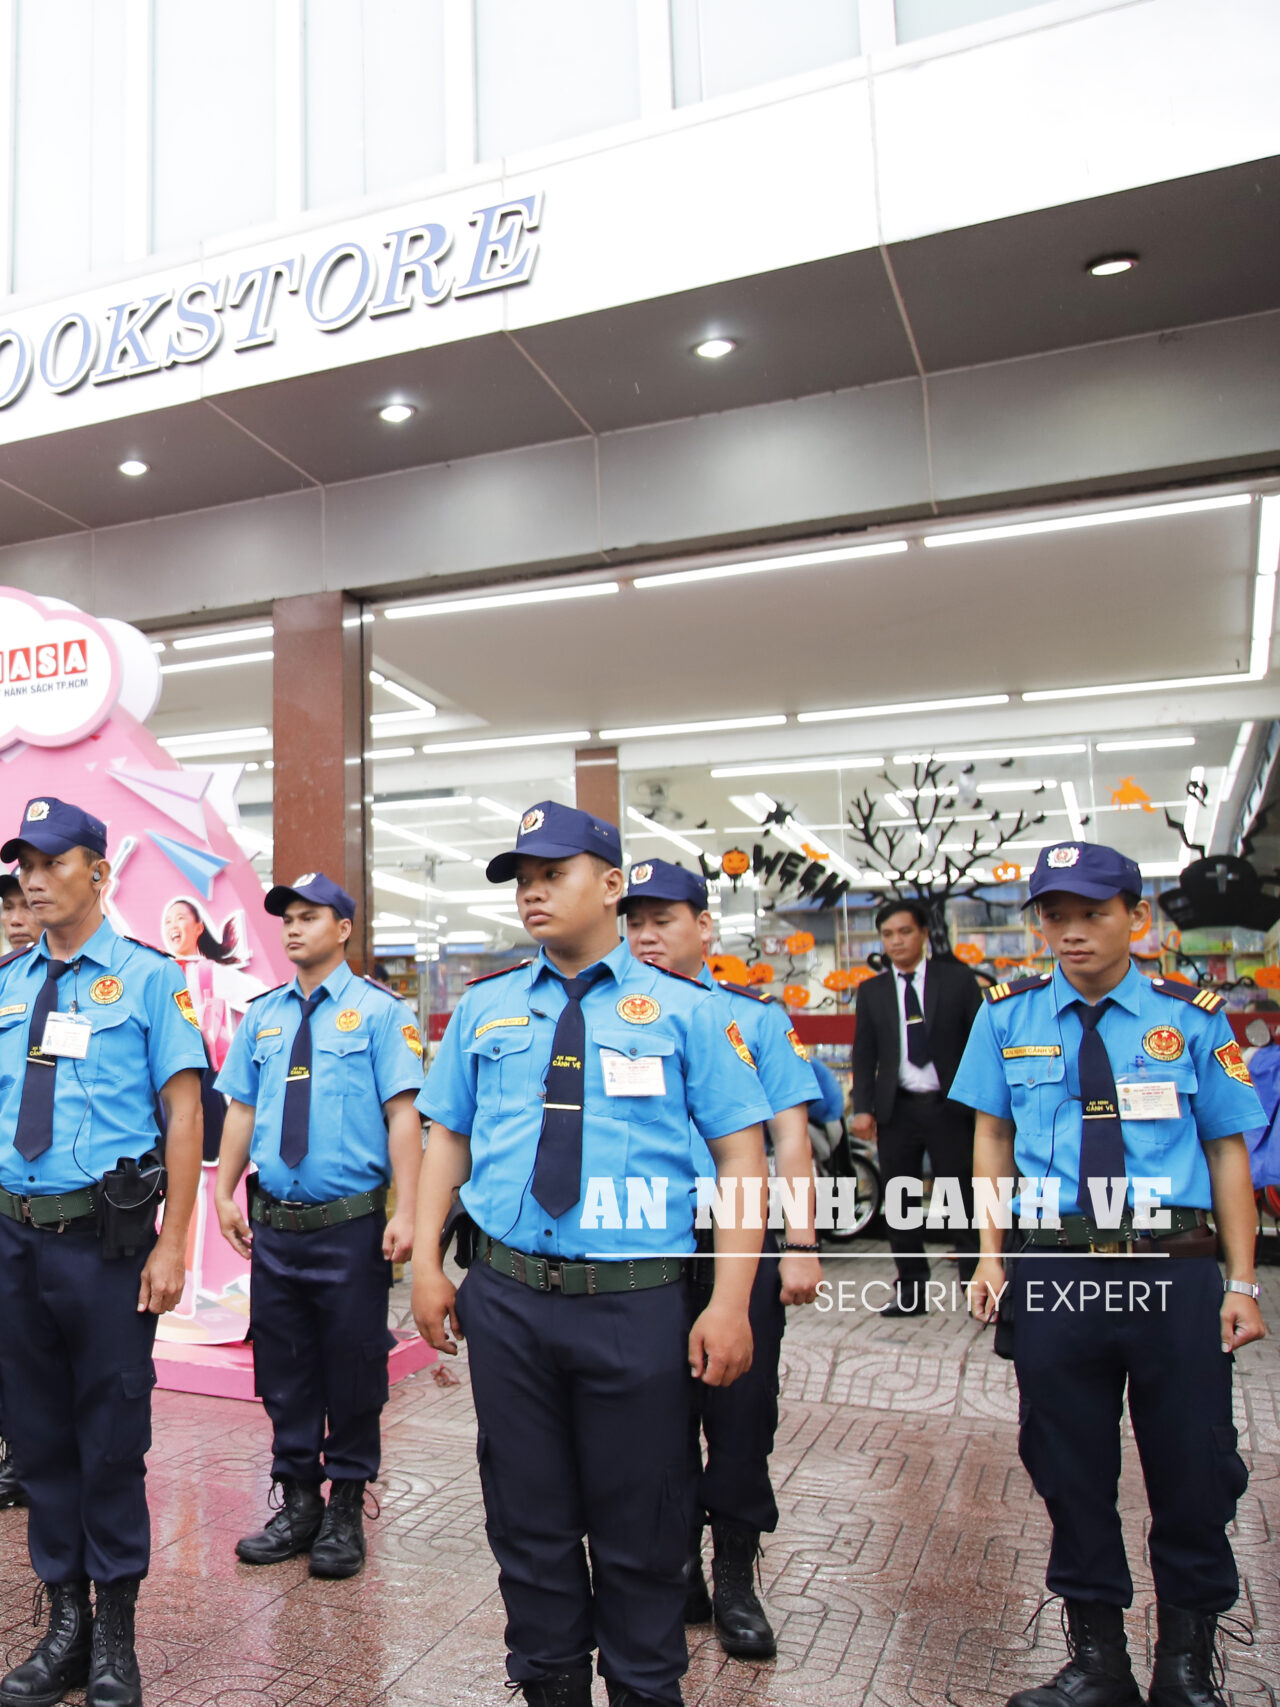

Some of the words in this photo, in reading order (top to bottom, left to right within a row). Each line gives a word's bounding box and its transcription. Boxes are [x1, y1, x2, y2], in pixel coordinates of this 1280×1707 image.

[4, 685, 28, 697] HÀNH
[31, 682, 53, 694] SÁCH
[56, 678, 88, 691] TP.HCM
